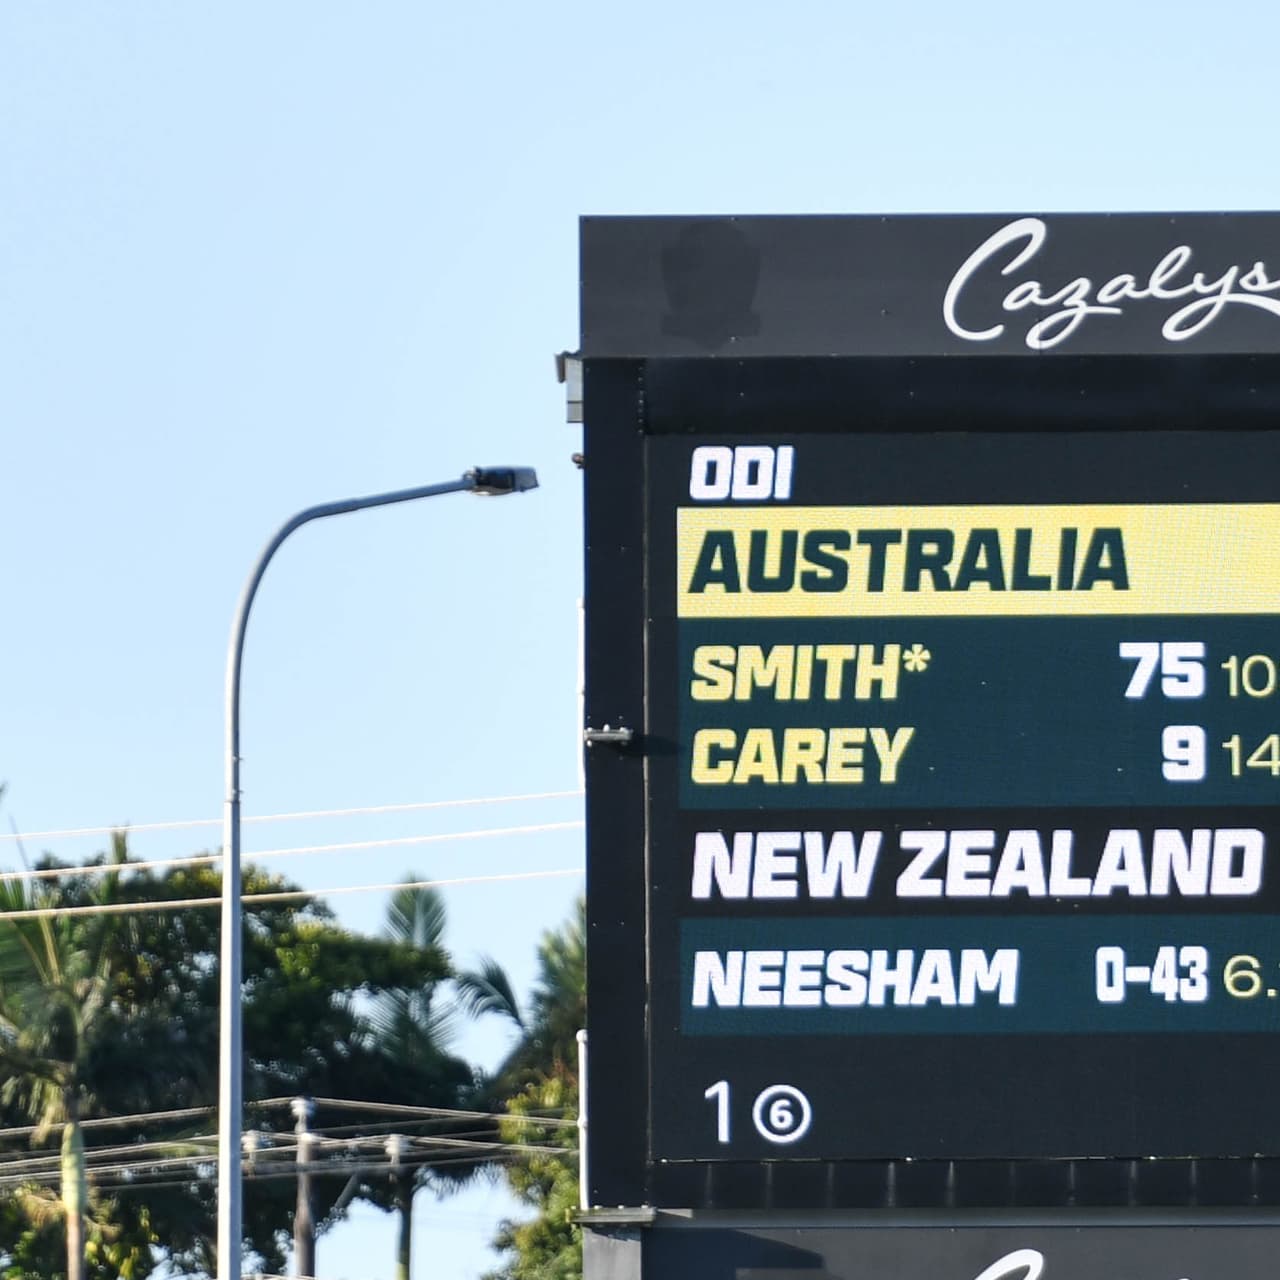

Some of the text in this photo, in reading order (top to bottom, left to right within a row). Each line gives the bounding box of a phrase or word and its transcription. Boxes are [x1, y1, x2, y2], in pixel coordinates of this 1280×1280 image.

[690, 446, 794, 500] ODI
[688, 528, 1131, 593] AUSTRALIA
[1119, 642, 1206, 699] 75
[692, 728, 914, 783] CAREY
[1162, 725, 1206, 782] 9
[692, 829, 1265, 898] NEW ZEALAND
[692, 949, 1020, 1008] NEESHAM
[1096, 946, 1209, 1004] 0-43
[704, 1080, 730, 1143] 1
